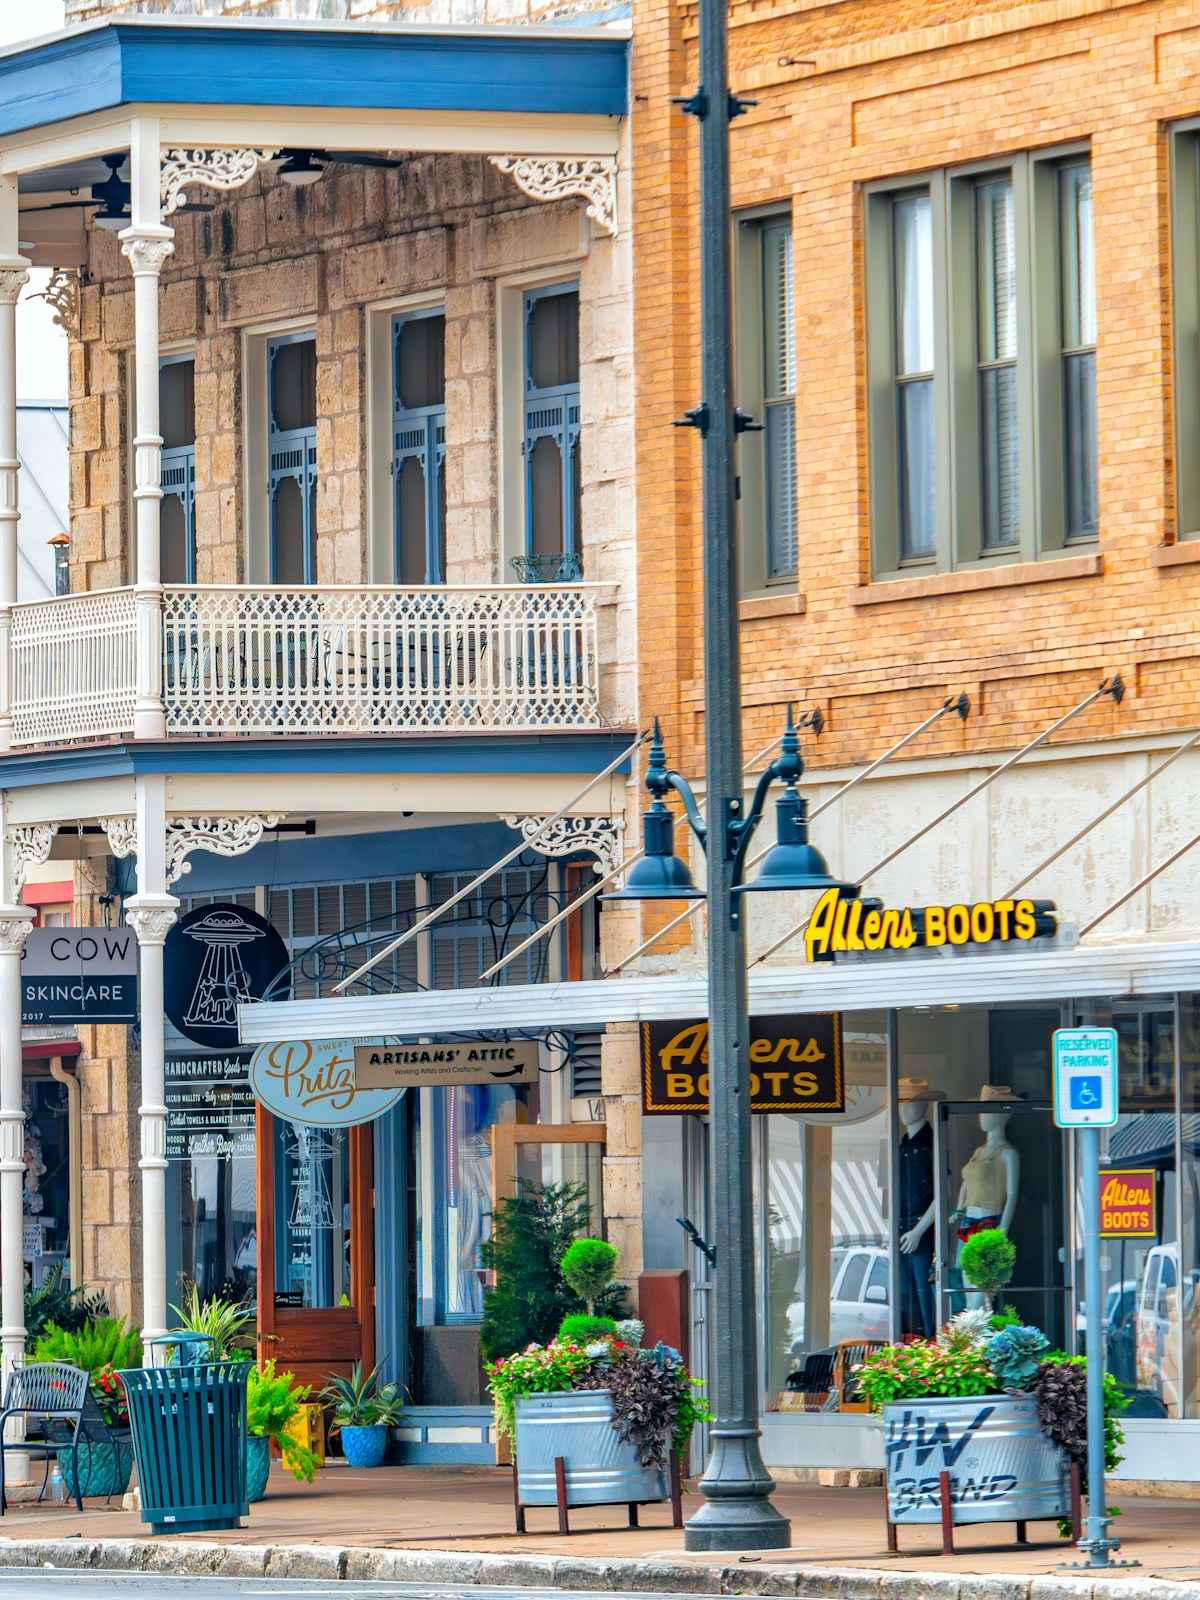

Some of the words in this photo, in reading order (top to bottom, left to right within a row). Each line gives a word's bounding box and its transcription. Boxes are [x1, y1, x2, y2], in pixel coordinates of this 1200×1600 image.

[804, 887, 917, 963] Allens
[924, 899, 1036, 946] BOOTS
[50, 937, 130, 961] COW
[26, 985, 123, 1001] SKINCARE
[22, 1013, 43, 1021] 2017
[318, 1041, 349, 1052] SWEET
[352, 1037, 376, 1046] SHOP
[658, 1022, 826, 1071] Aens
[1060, 1039, 1111, 1051] RESERVED
[370, 1050, 461, 1066] ARTISANS'
[468, 1048, 516, 1062] ATTIC
[1062, 1055, 1108, 1067] PARKING
[165, 1061, 222, 1076] HANDCRAFTED
[264, 1040, 355, 1110] Pritz
[667, 1072, 819, 1098] BTS
[182, 1093, 200, 1102] WALLETS
[246, 1092, 255, 1100] CAN
[187, 1116, 204, 1125] TOWELS
[210, 1115, 233, 1124] BLANKETS
[240, 1114, 255, 1123] POTTE
[167, 1147, 181, 1155] DECOR
[188, 1132, 215, 1154] Leather
[217, 1133, 235, 1161] Bags
[1101, 1177, 1151, 1210] Allens
[1103, 1212, 1149, 1228] BOOTS
